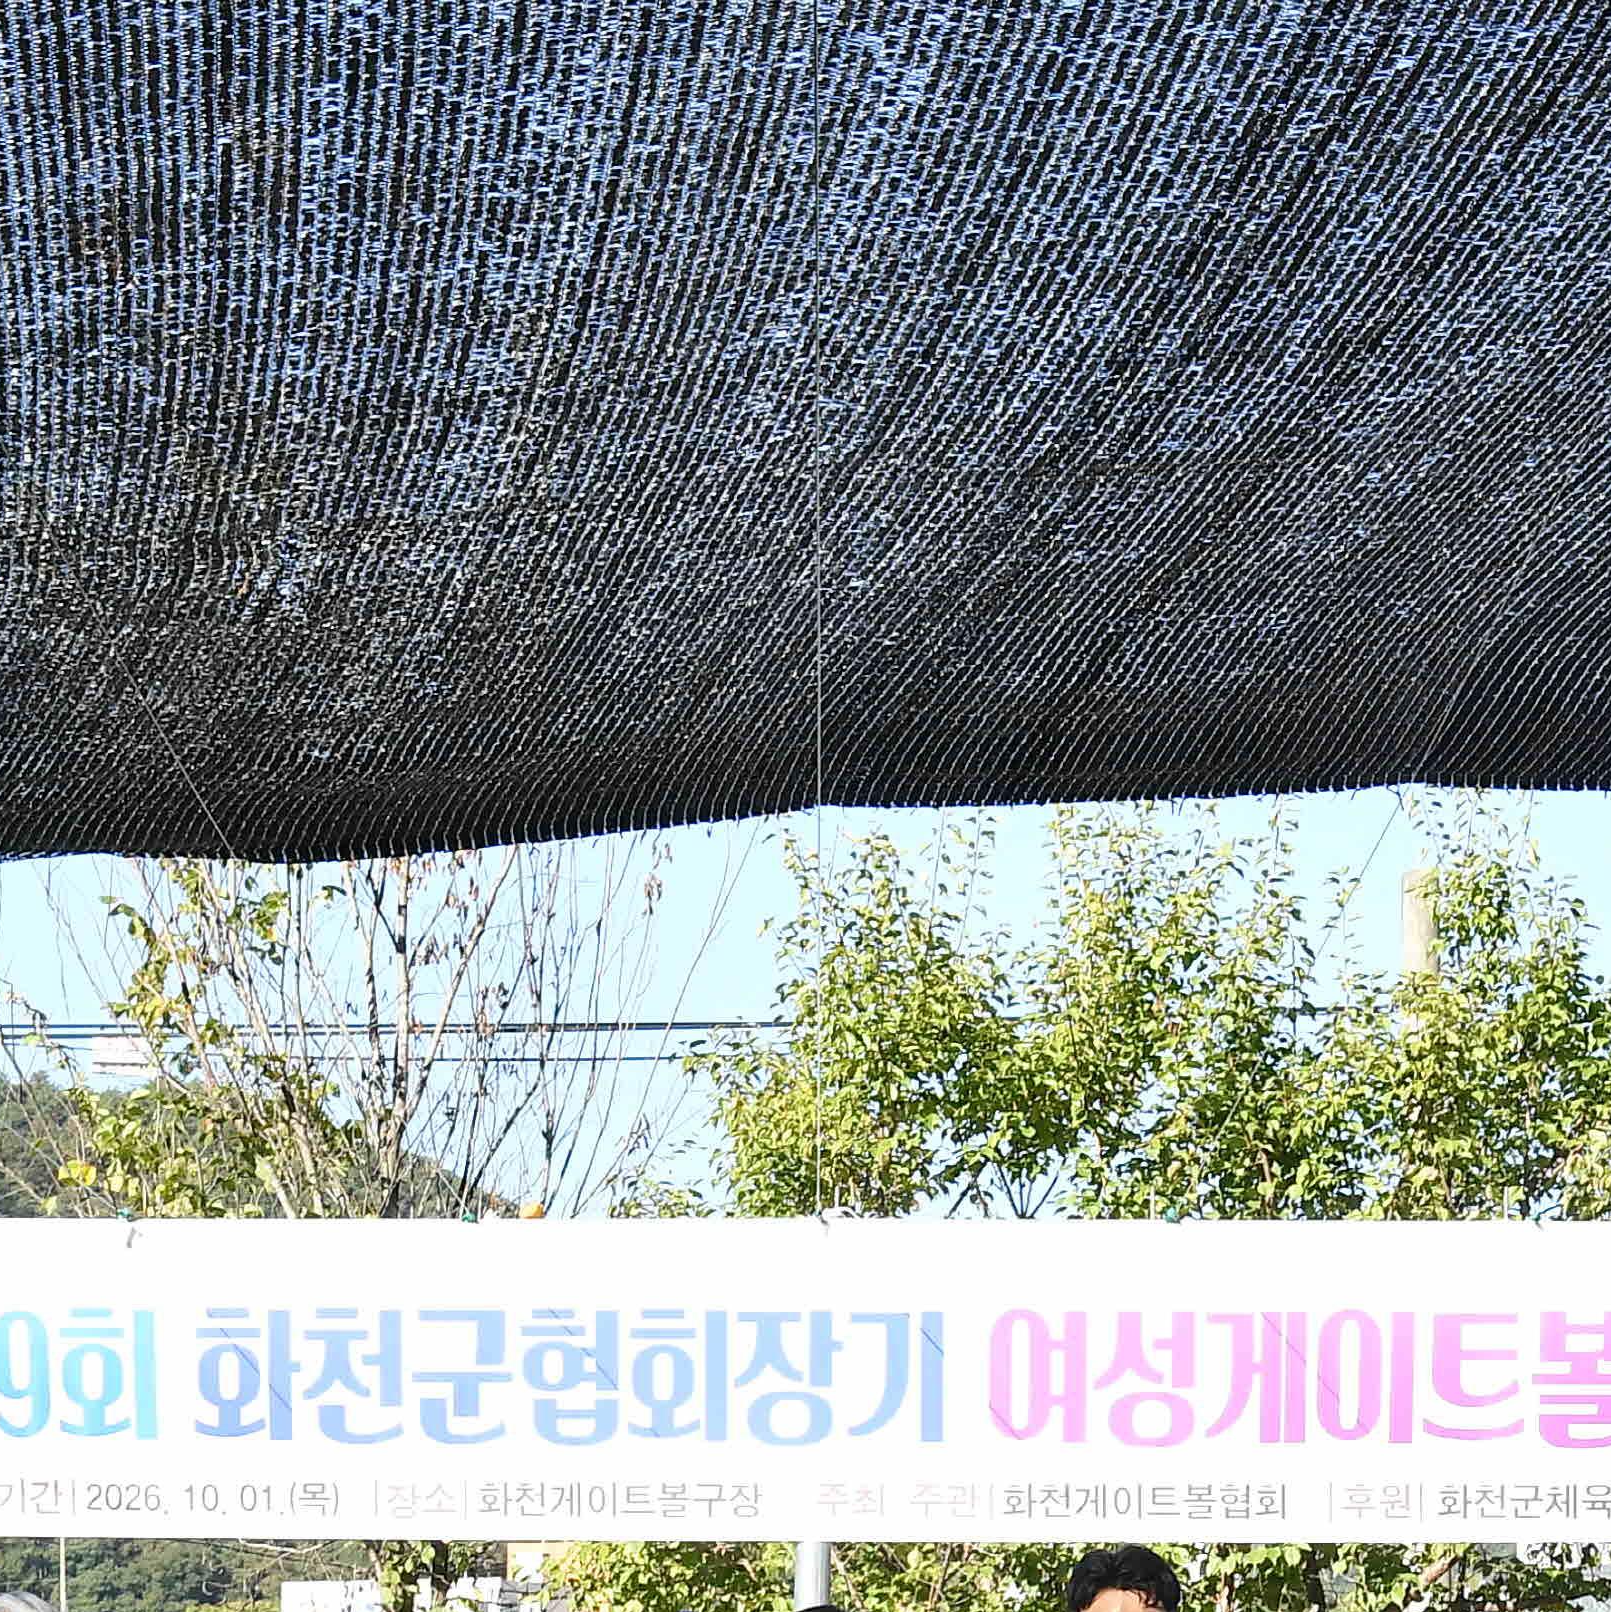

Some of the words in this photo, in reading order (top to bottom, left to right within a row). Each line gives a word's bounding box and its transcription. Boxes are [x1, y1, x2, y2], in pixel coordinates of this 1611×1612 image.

[194, 1305, 946, 1447] 화천군협회장기
[388, 1481, 458, 1520] 장소
[479, 1481, 764, 1520] 화천게이트볼구장
[817, 1482, 886, 1519] 주최
[909, 1482, 979, 1519] 주관
[1003, 1483, 1288, 1521] 화천게이트볼협회
[1342, 1484, 1412, 1520] 후원
